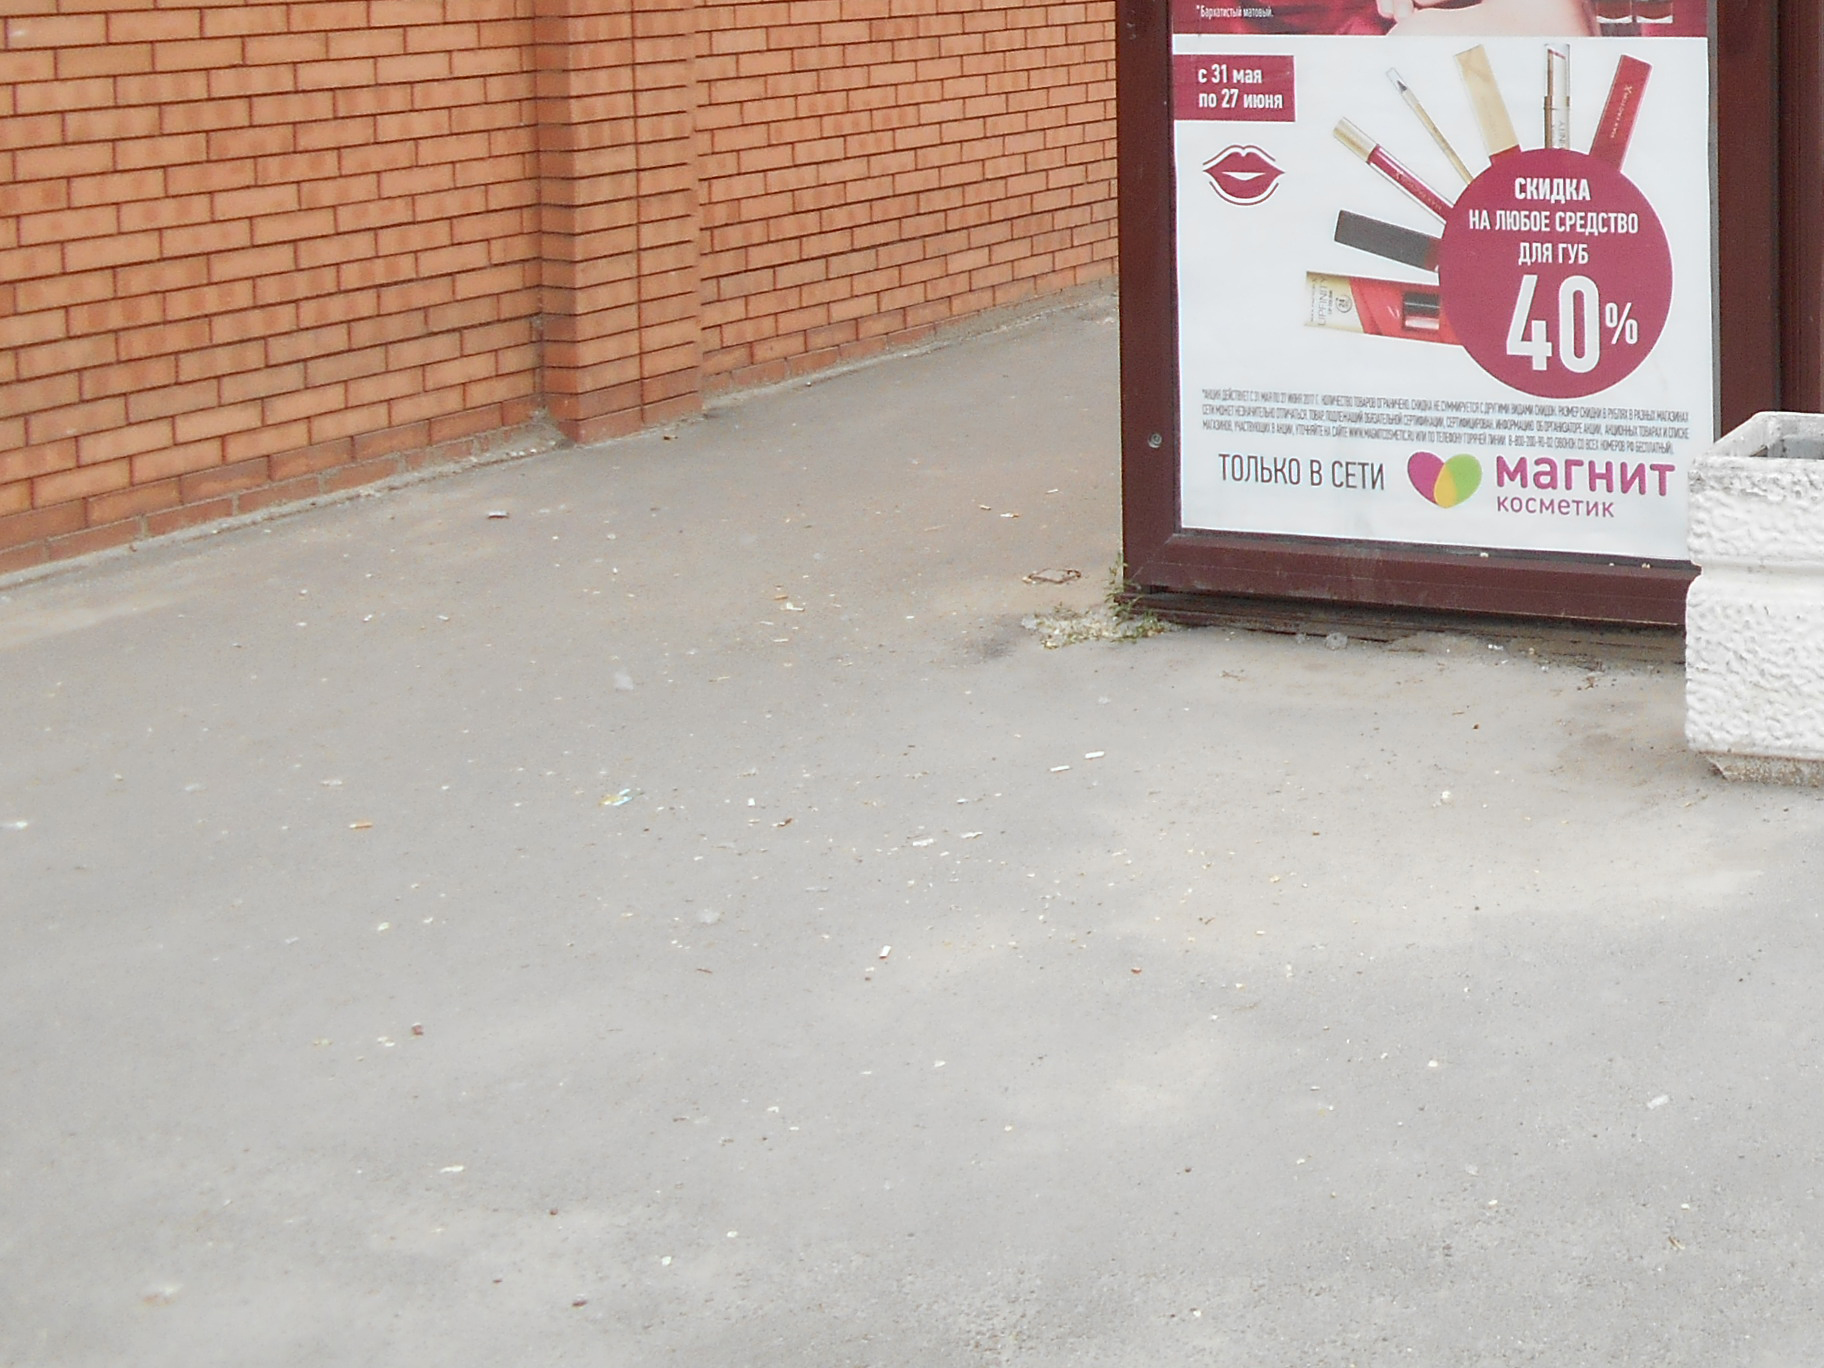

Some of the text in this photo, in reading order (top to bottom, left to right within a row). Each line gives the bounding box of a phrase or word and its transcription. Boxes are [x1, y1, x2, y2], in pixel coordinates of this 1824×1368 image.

[1211, 65, 1228, 85] 31
[1231, 67, 1263, 86] мая
[1198, 89, 1284, 111] по 27 июня
[1514, 177, 1592, 206] СКИДКА
[1469, 209, 1640, 239] НА ЛЮБОЕ СРЕДСТВО
[1518, 242, 1589, 266] ДЛЯ ГУБ
[1505, 274, 1639, 374] 40%
[1218, 453, 1386, 491] ТОЛЬКО В СЕТИ
[1496, 455, 1676, 498] магнит
[1496, 494, 1616, 519] косметик
